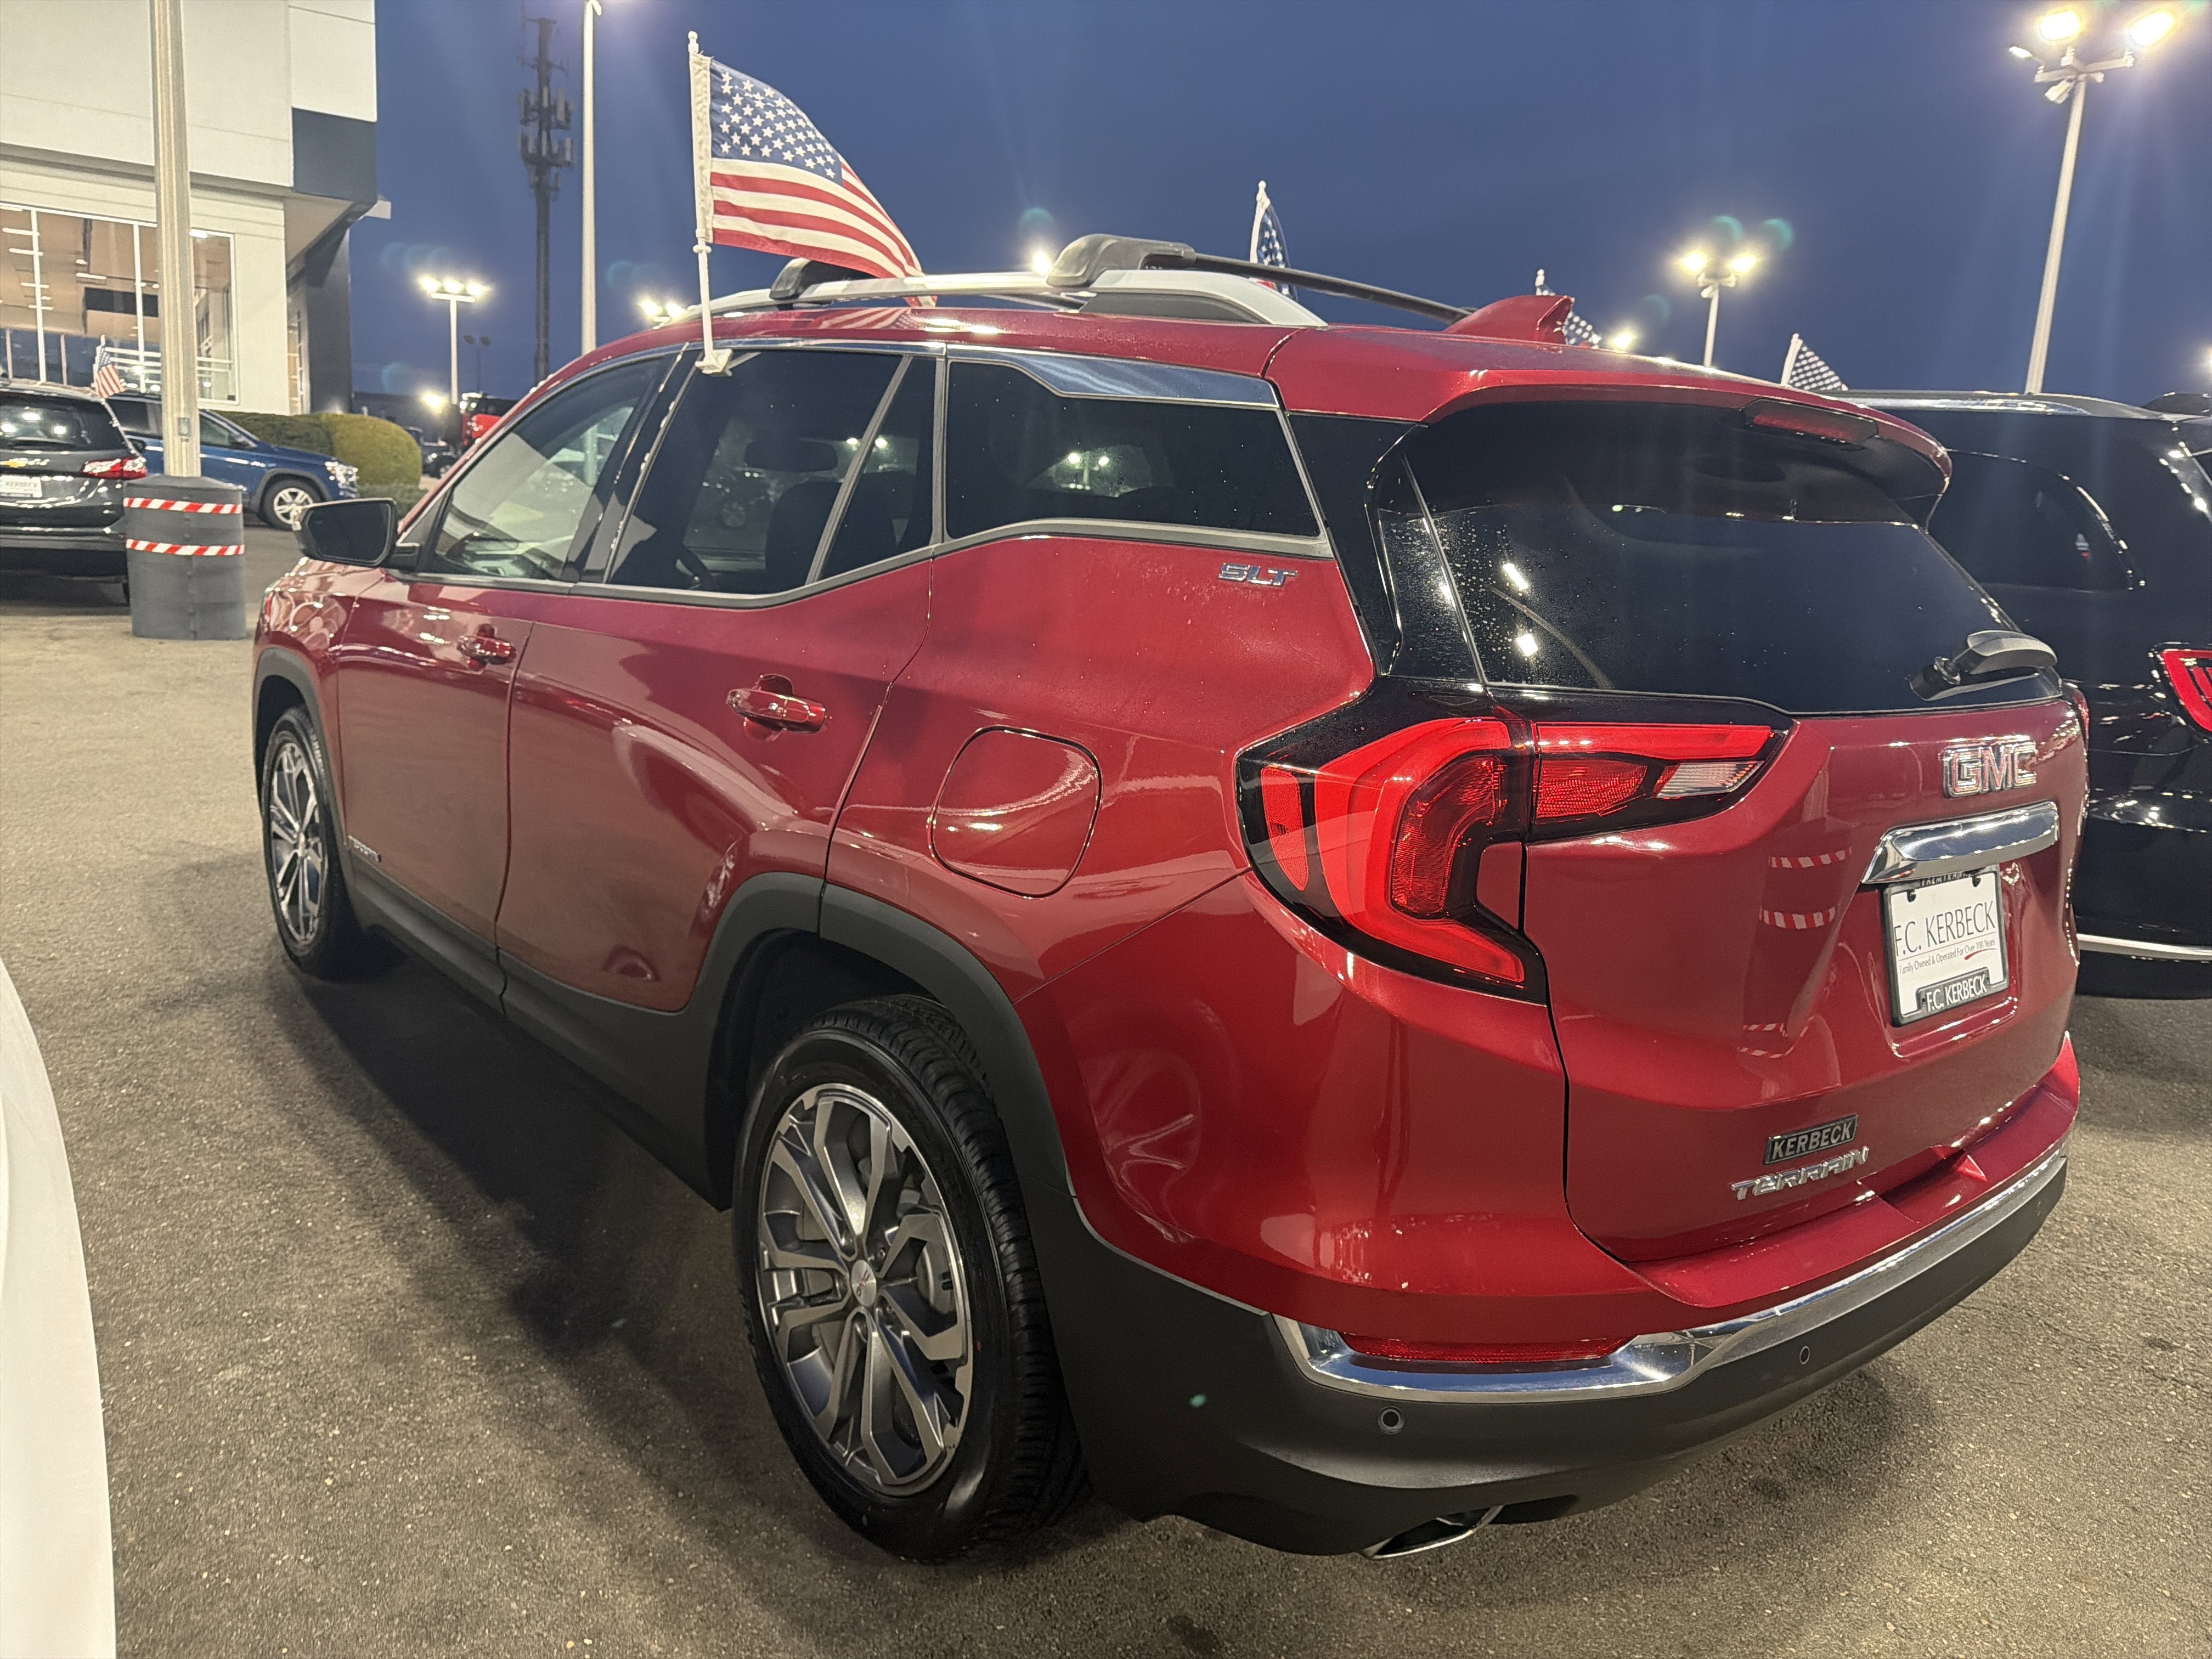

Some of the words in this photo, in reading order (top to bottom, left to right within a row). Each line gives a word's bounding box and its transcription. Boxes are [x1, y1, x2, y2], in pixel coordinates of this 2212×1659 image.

[1943, 742, 2037, 798] GMC
[1894, 921, 1922, 956] F.C.
[1925, 900, 1996, 947] KERBECK
[1899, 962, 1914, 975] Family
[1914, 957, 1931, 970] Owned
[1936, 950, 1956, 964] Operated
[1965, 945, 1975, 953] Over
[1984, 939, 1995, 947] Years
[1926, 989, 1945, 1012] F.C.
[1945, 974, 1988, 1006] KERBECK
[1218, 1111, 1298, 1136] SLT
[1772, 1121, 1853, 1160] KERBECK
[1731, 1146, 1870, 1200] TERRAIN
[856, 1269, 870, 1297] GMC
